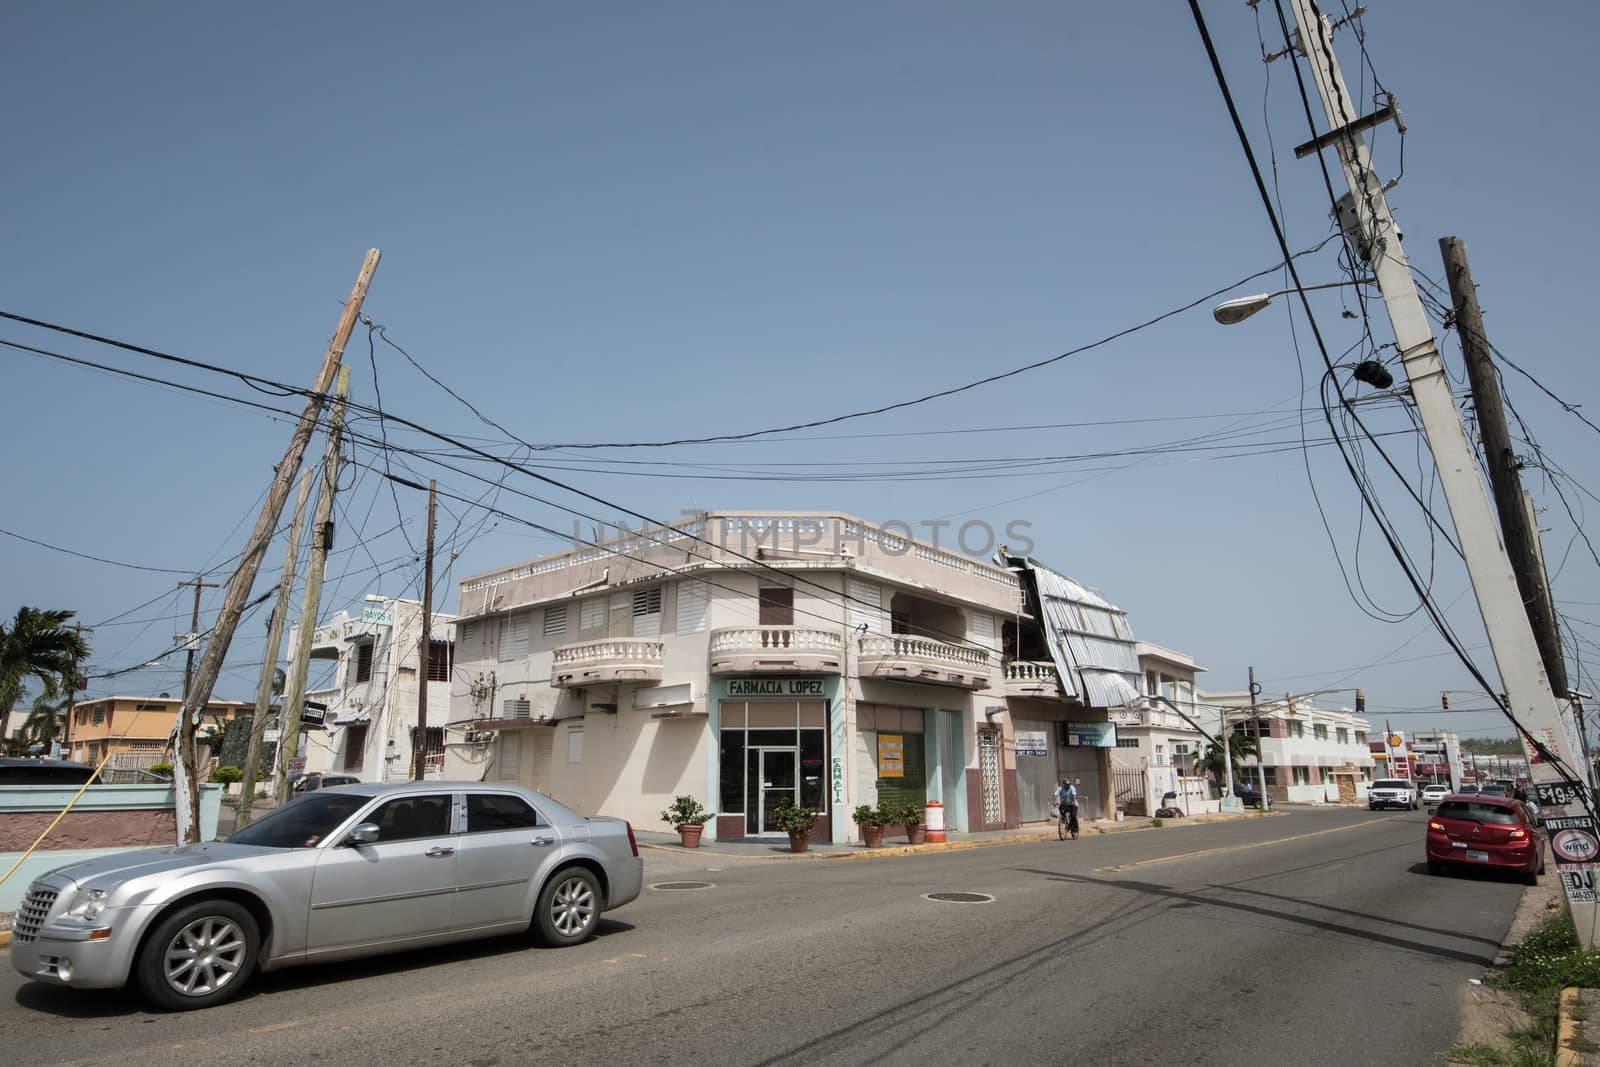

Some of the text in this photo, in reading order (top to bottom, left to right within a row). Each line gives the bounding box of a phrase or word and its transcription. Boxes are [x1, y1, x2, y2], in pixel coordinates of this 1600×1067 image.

[730, 680, 823, 694] FARMACIA LOPEZ
[833, 757, 843, 804] FARMACIA
[1563, 842, 1590, 852] wind
[1571, 871, 1594, 890] DJ
